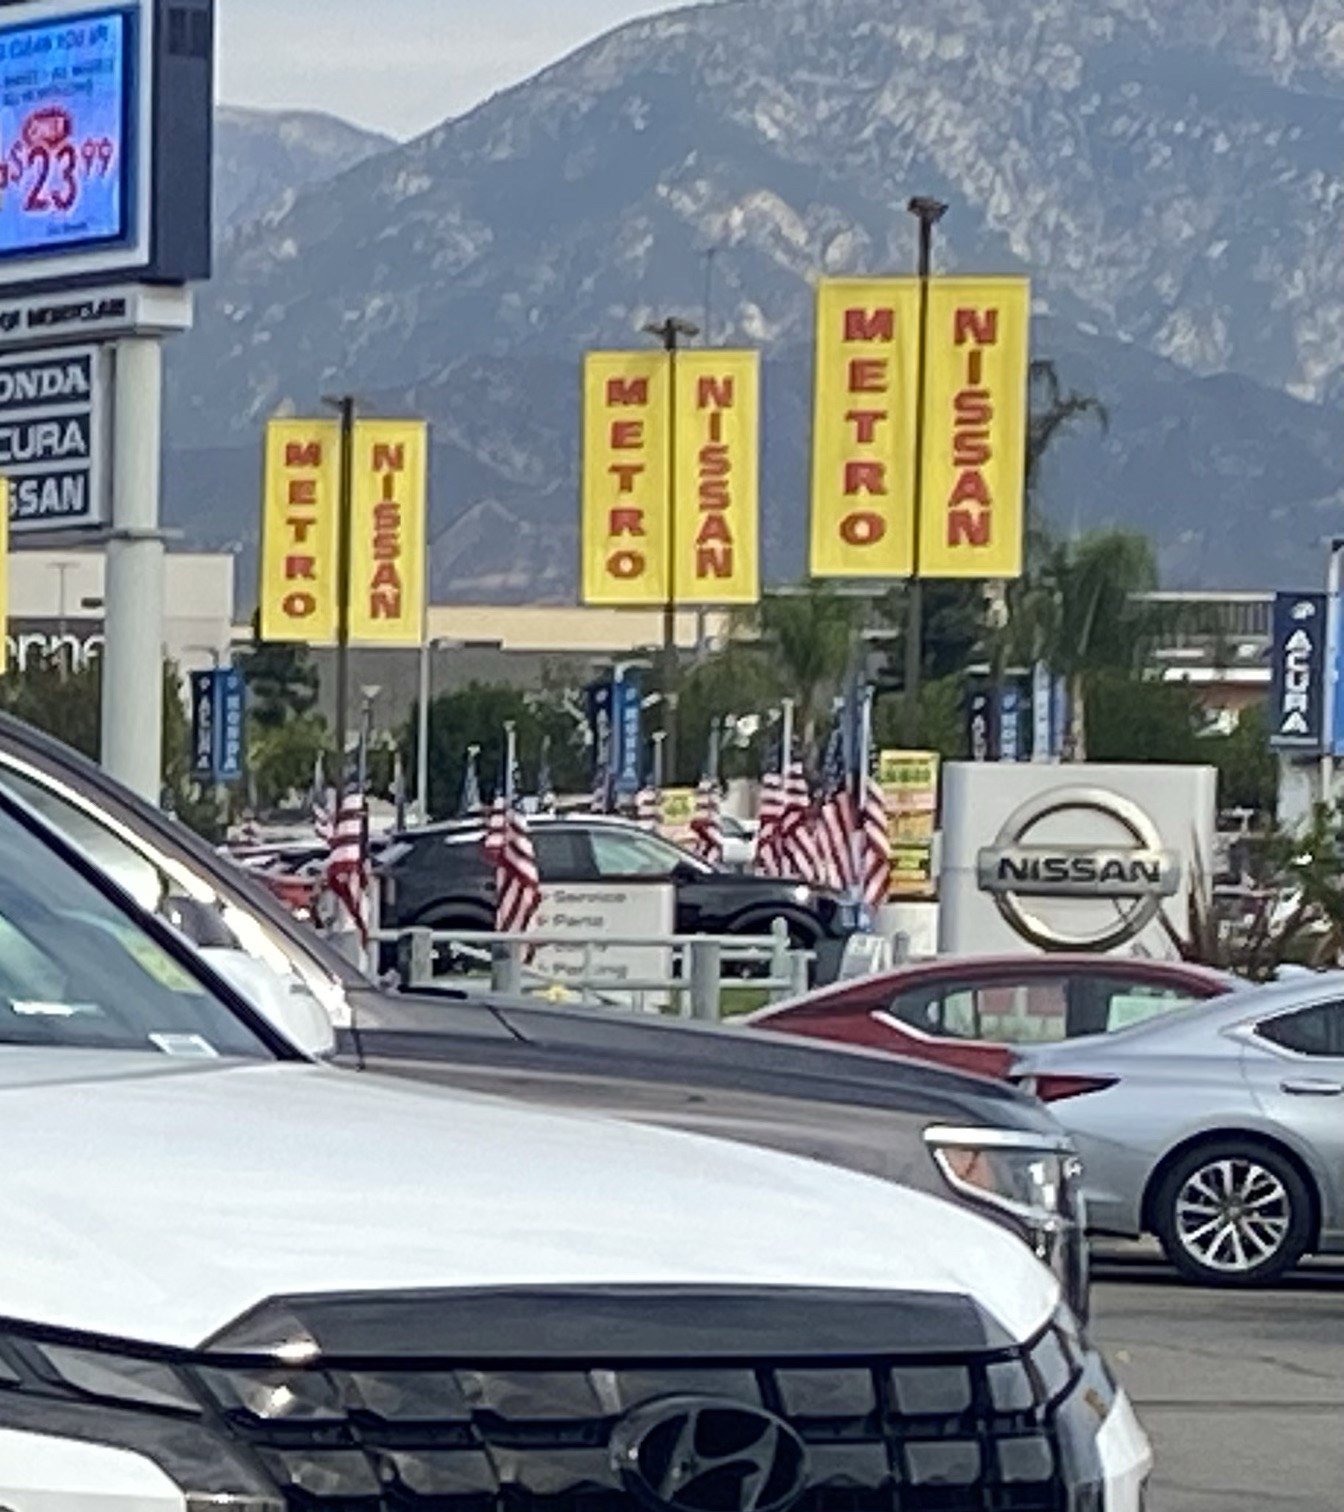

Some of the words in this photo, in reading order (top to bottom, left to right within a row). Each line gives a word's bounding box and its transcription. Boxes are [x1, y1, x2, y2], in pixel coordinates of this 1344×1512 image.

[0, 310, 20, 331] OF
[605, 377, 649, 580] METRO
[695, 376, 733, 579] NISSAN
[839, 309, 895, 546] METRO
[946, 308, 997, 548] NISSAN
[282, 442, 322, 620] METRO
[369, 442, 404, 619] NISSAN
[1280, 629, 1313, 735] ACURA
[996, 856, 1161, 884] NISSAN
[552, 963, 628, 979] Paring
